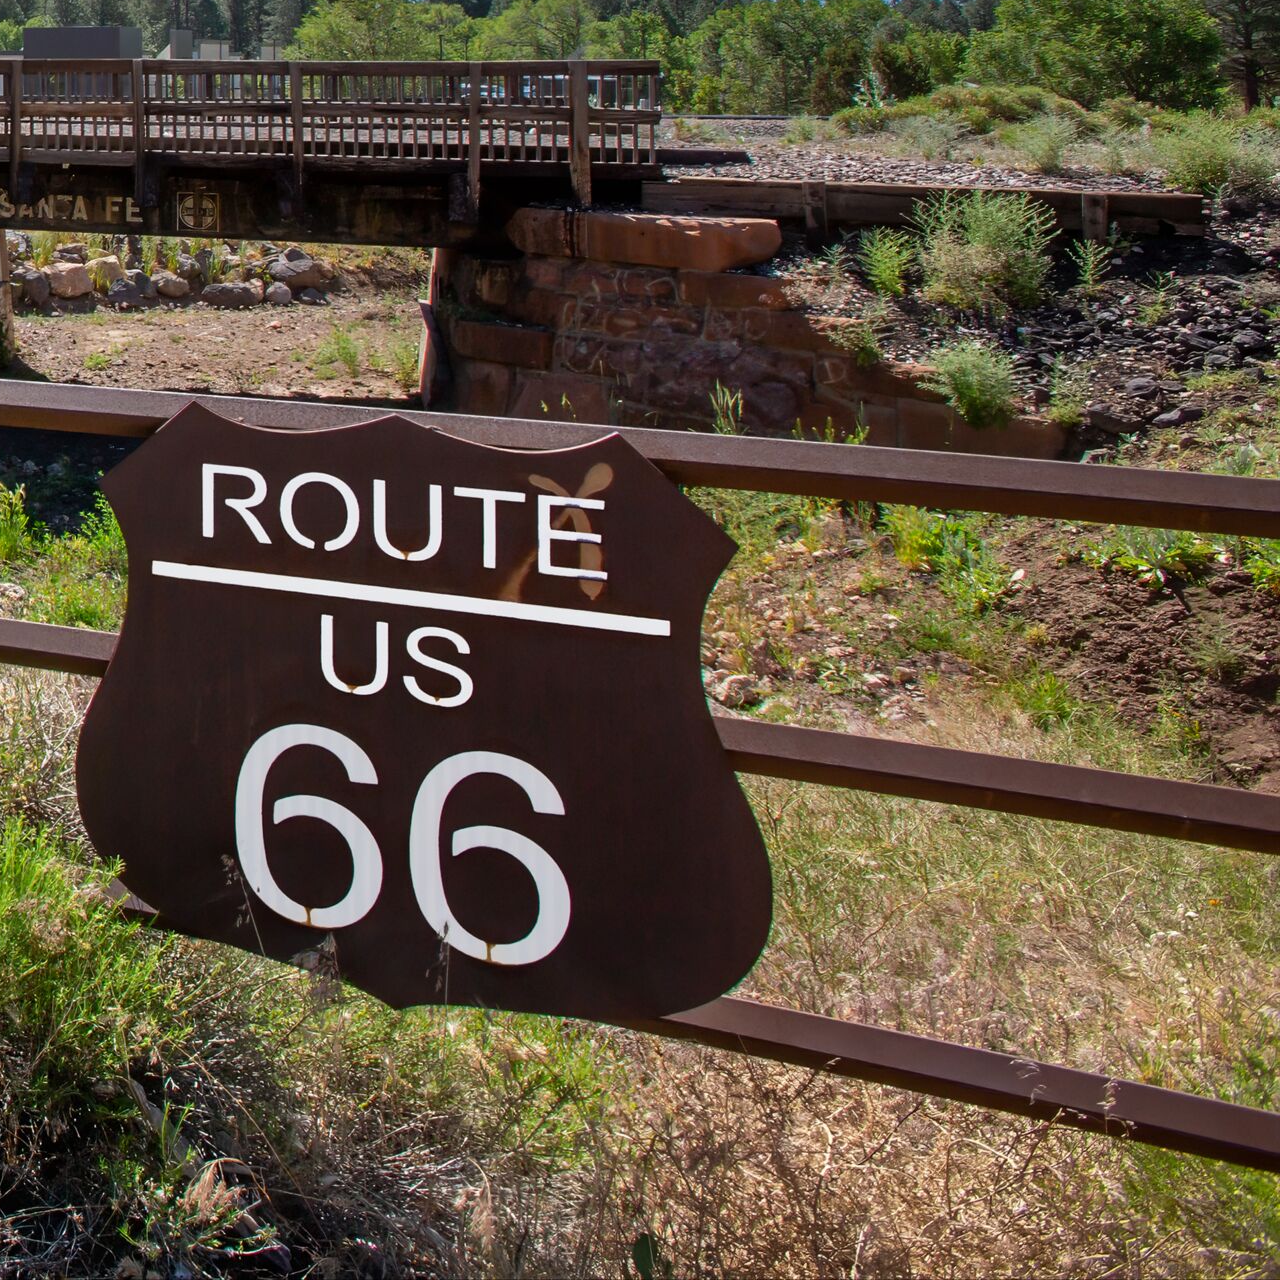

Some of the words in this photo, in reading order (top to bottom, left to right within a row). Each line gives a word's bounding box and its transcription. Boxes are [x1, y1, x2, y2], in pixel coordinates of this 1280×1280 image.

[201, 462, 608, 582] ROUTE
[320, 613, 474, 708] US
[234, 723, 572, 966] 66
